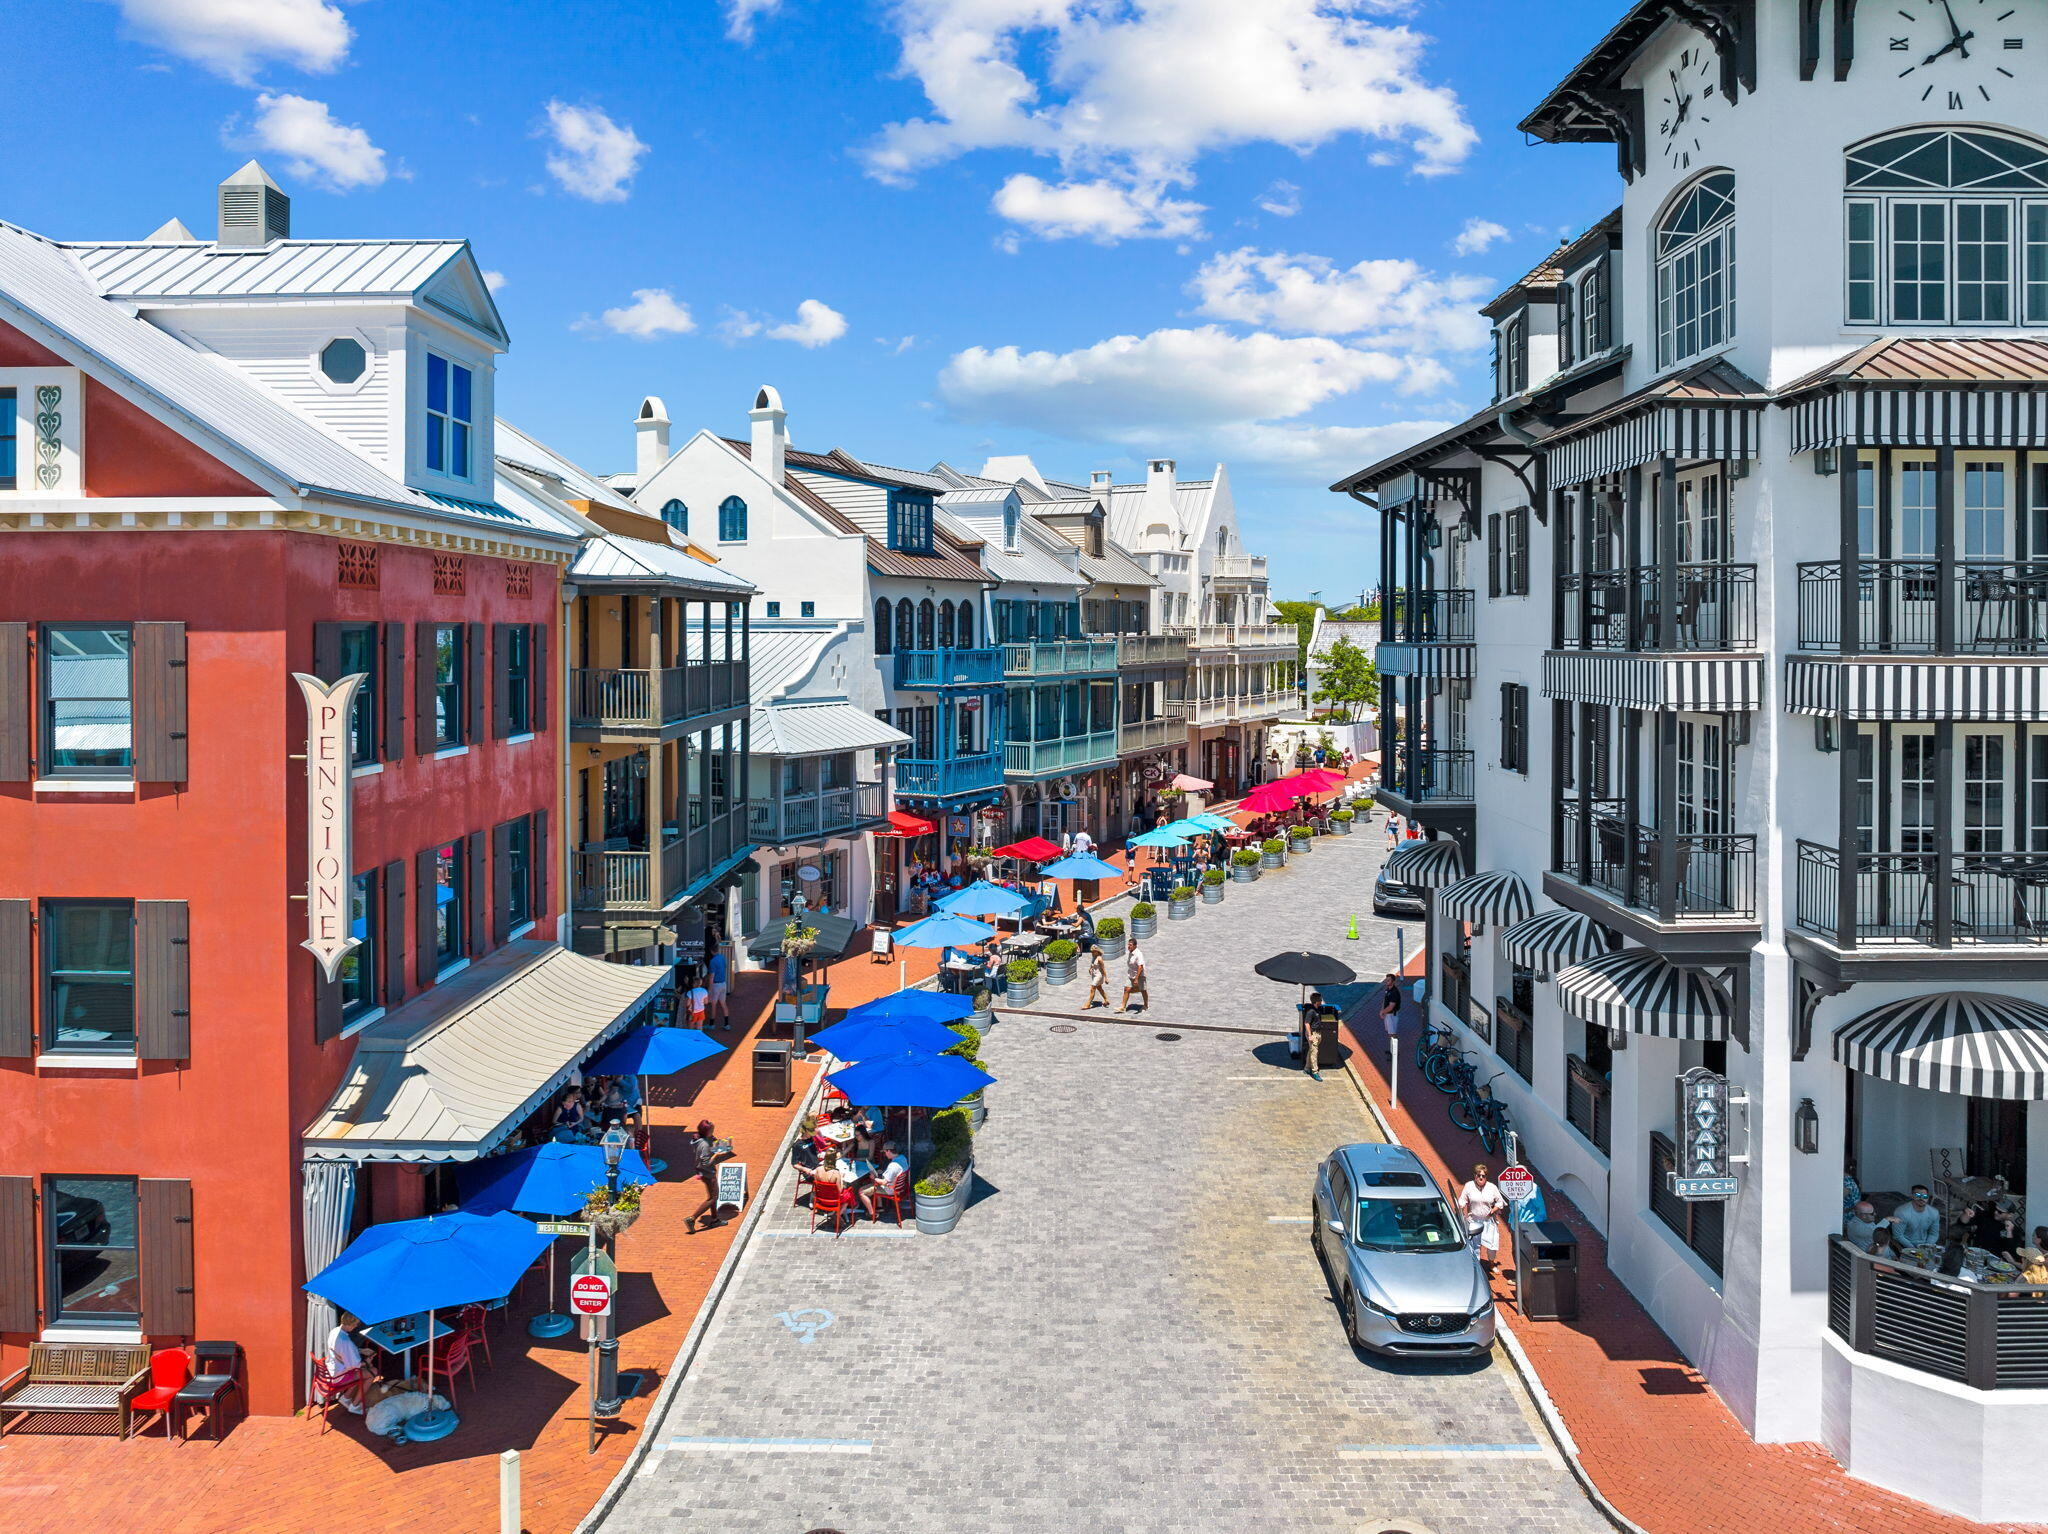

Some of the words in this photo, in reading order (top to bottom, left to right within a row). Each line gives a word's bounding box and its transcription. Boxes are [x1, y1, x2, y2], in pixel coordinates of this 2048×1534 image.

[2003, 38, 2023, 50] III
[316, 706, 340, 940] PENSIONE
[1694, 1084, 1717, 1175] HAVANA
[1505, 1171, 1527, 1180] STOP
[1679, 1181, 1734, 1191] BEACH
[538, 1224, 555, 1232] WEST
[557, 1224, 578, 1233] WATER
